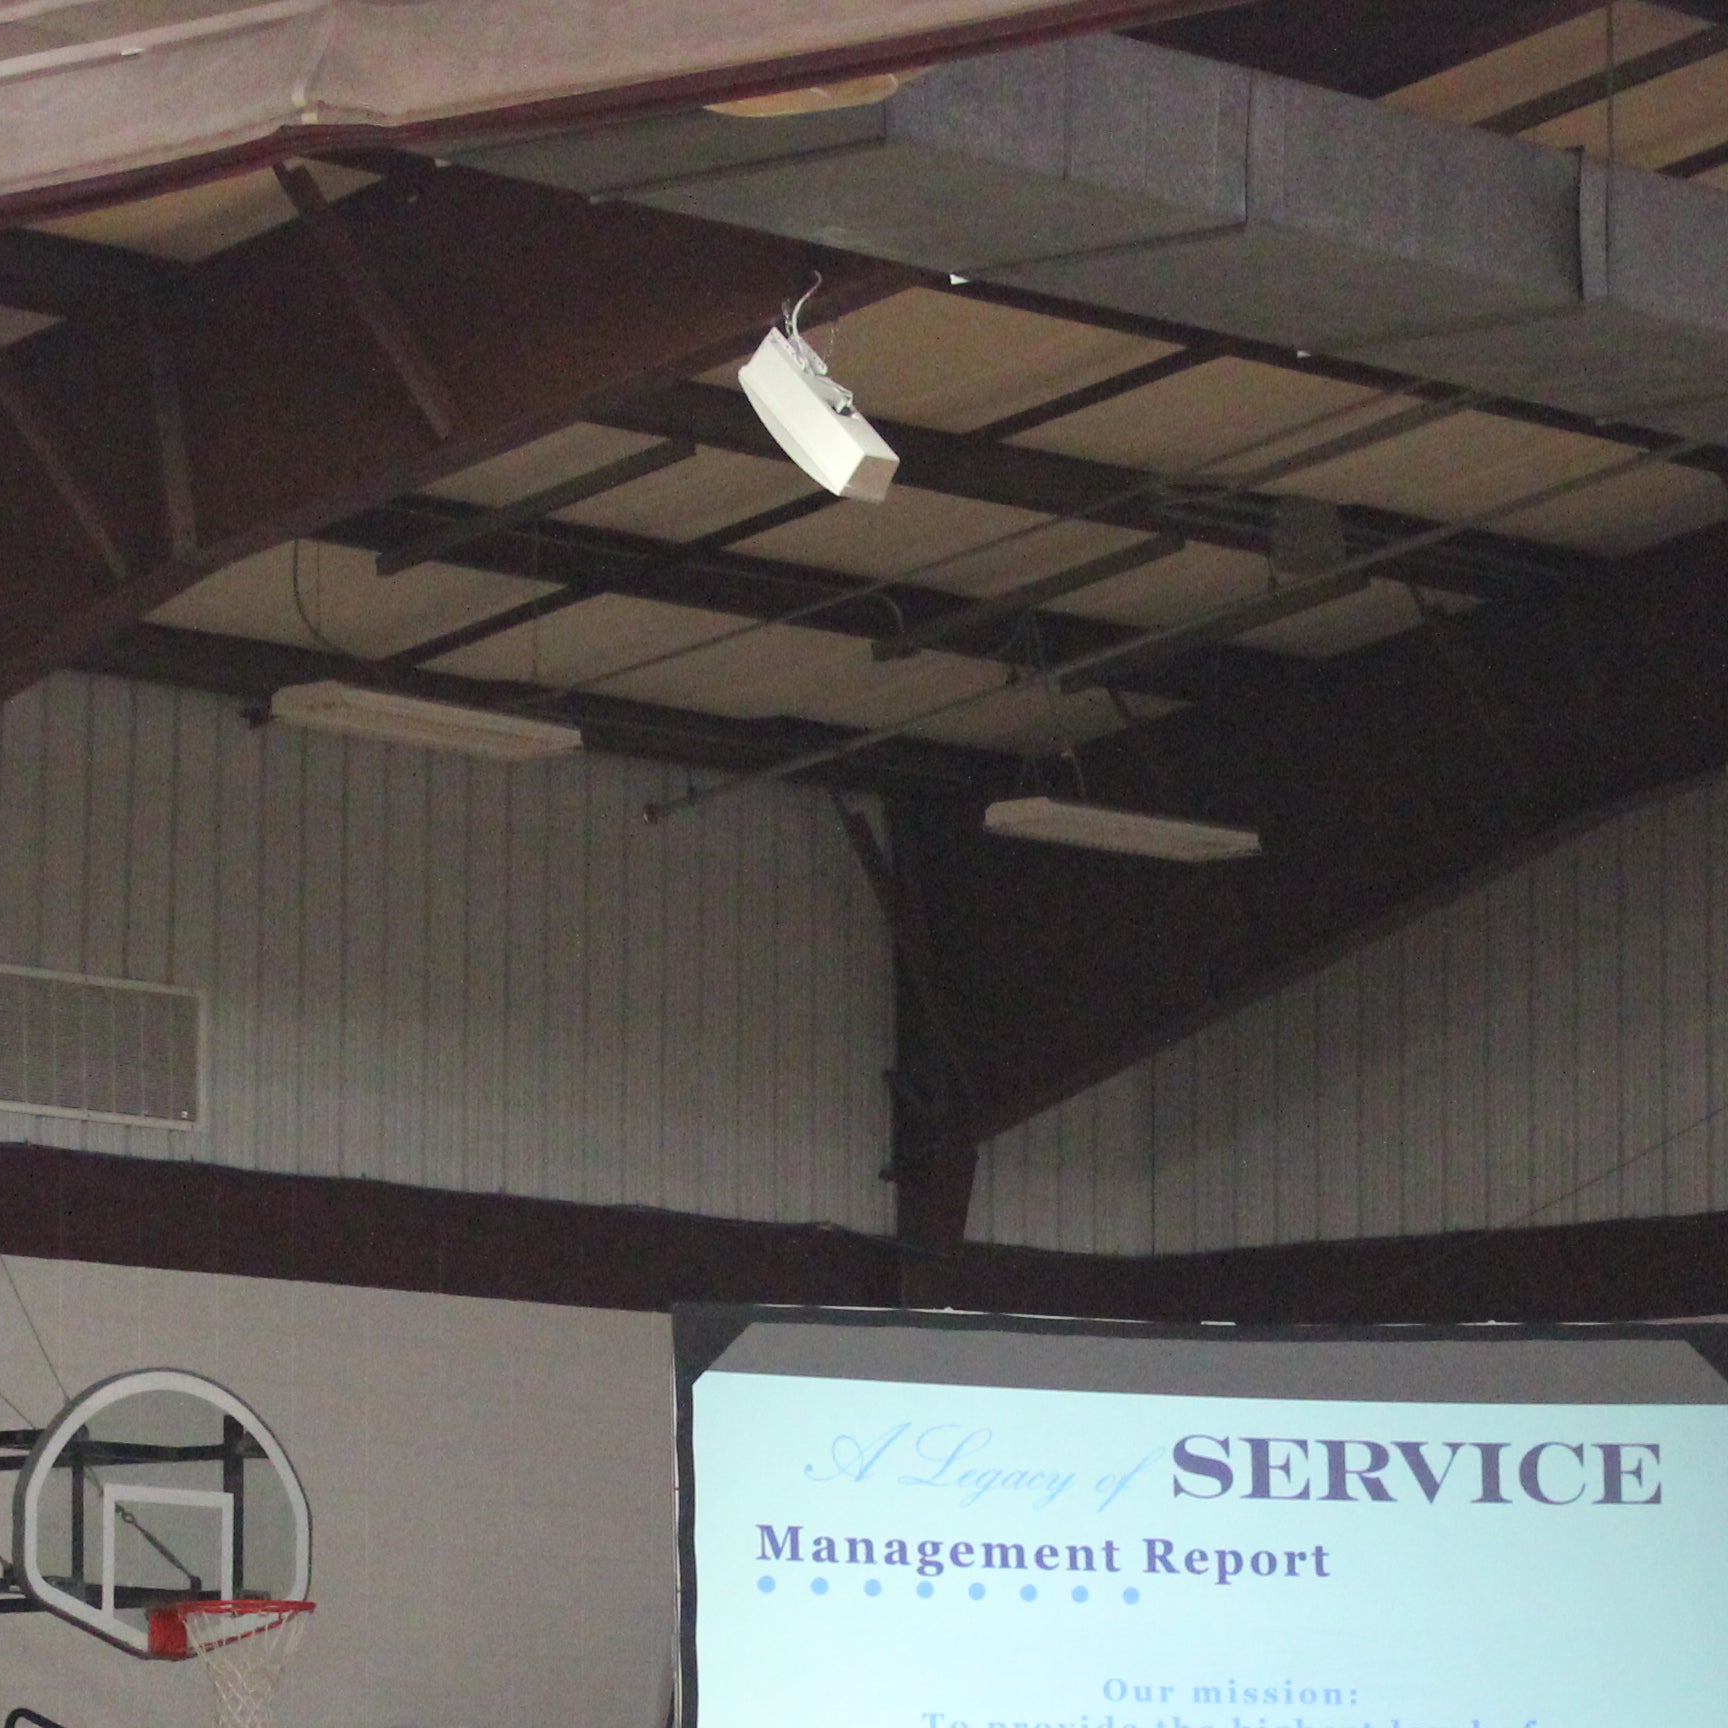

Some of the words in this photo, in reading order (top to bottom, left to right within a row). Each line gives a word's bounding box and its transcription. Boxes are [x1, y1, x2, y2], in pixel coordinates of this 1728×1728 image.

[803, 1422, 911, 1482] A
[898, 1425, 1075, 1508] Legacy
[1096, 1446, 1166, 1512] of
[1172, 1434, 1663, 1505] SERVICE
[756, 1524, 1121, 1577] Management
[1144, 1539, 1330, 1584] Report
[1103, 1679, 1175, 1703] Our
[1193, 1679, 1357, 1706] mission:
